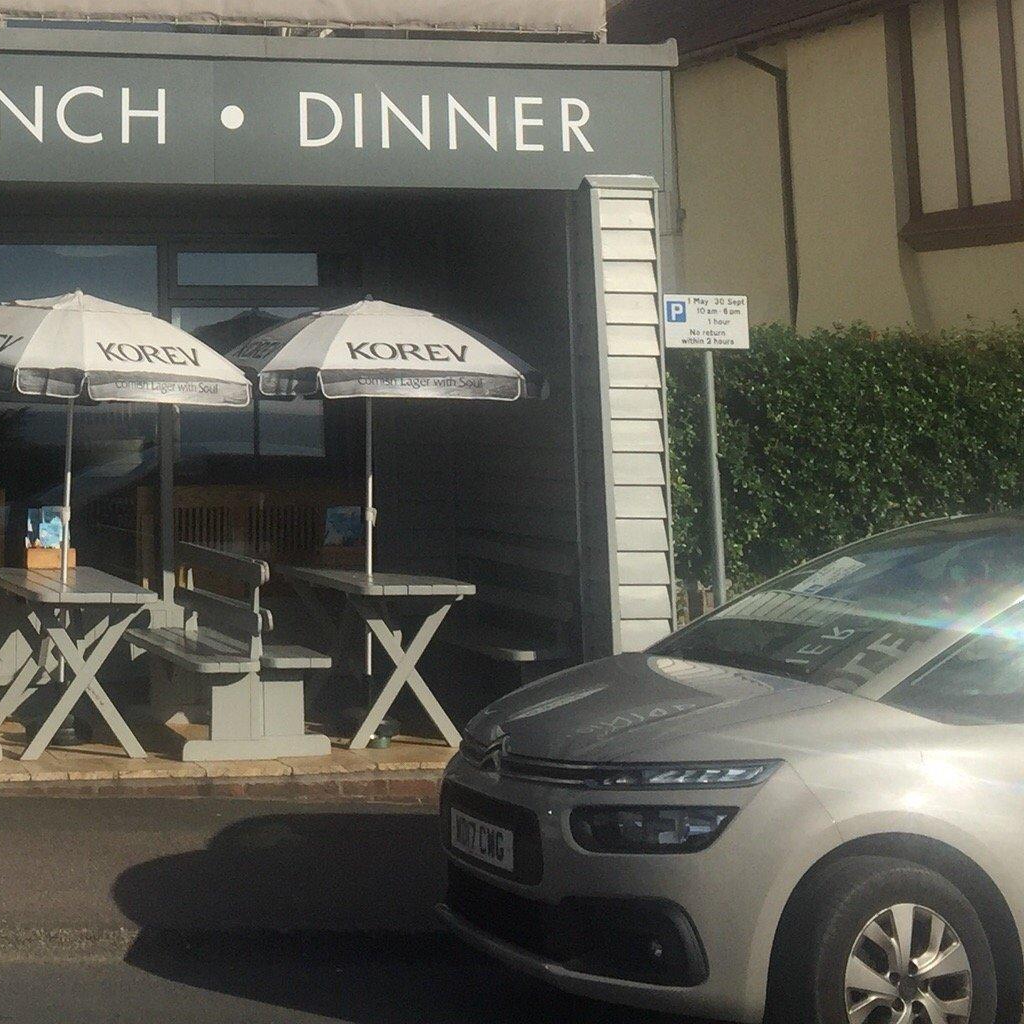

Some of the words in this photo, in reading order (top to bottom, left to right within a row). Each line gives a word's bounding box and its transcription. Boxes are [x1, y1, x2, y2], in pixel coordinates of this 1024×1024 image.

[299, 91, 594, 153] DINNER
[693, 298, 709, 306] May
[727, 298, 745, 306] Sept
[681, 337, 705, 345] within
[713, 337, 735, 345] hours
[95, 341, 201, 367] KOREV
[346, 342, 468, 363] KOREV
[151, 380, 176, 394] Lager
[179, 381, 196, 392] with
[198, 382, 219, 394] Soul
[400, 376, 430, 389] Lager
[433, 376, 456, 387] with
[458, 376, 483, 388] Soul
